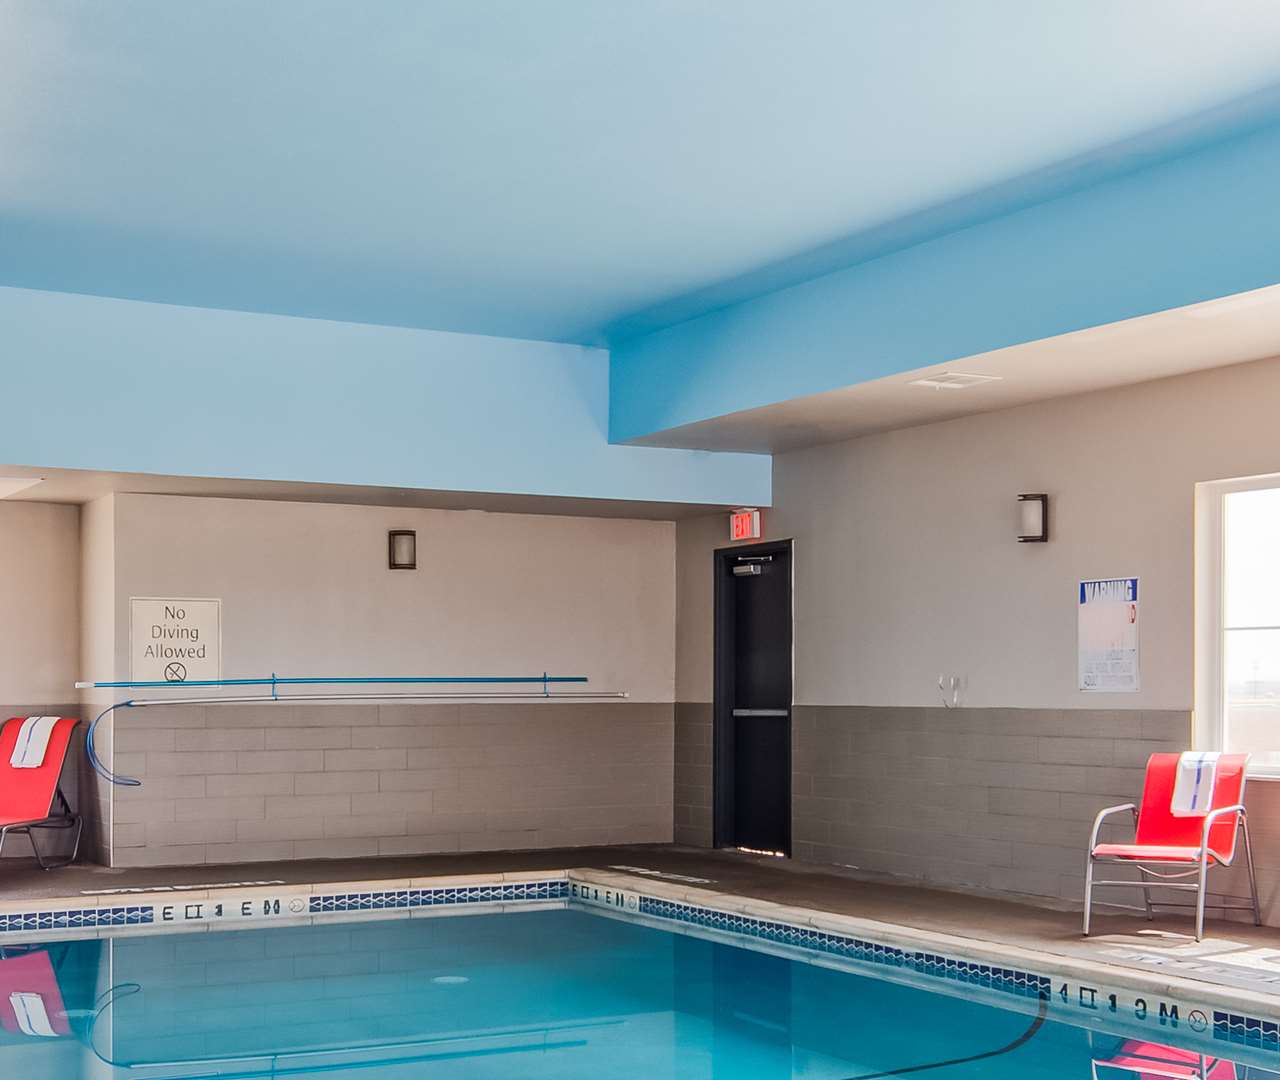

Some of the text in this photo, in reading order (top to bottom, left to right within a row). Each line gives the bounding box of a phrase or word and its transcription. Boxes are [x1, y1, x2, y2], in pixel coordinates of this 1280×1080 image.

[1084, 580, 1133, 602] WARNING
[164, 605, 186, 620] No
[151, 623, 199, 643] Diving
[143, 643, 206, 659] Allowed
